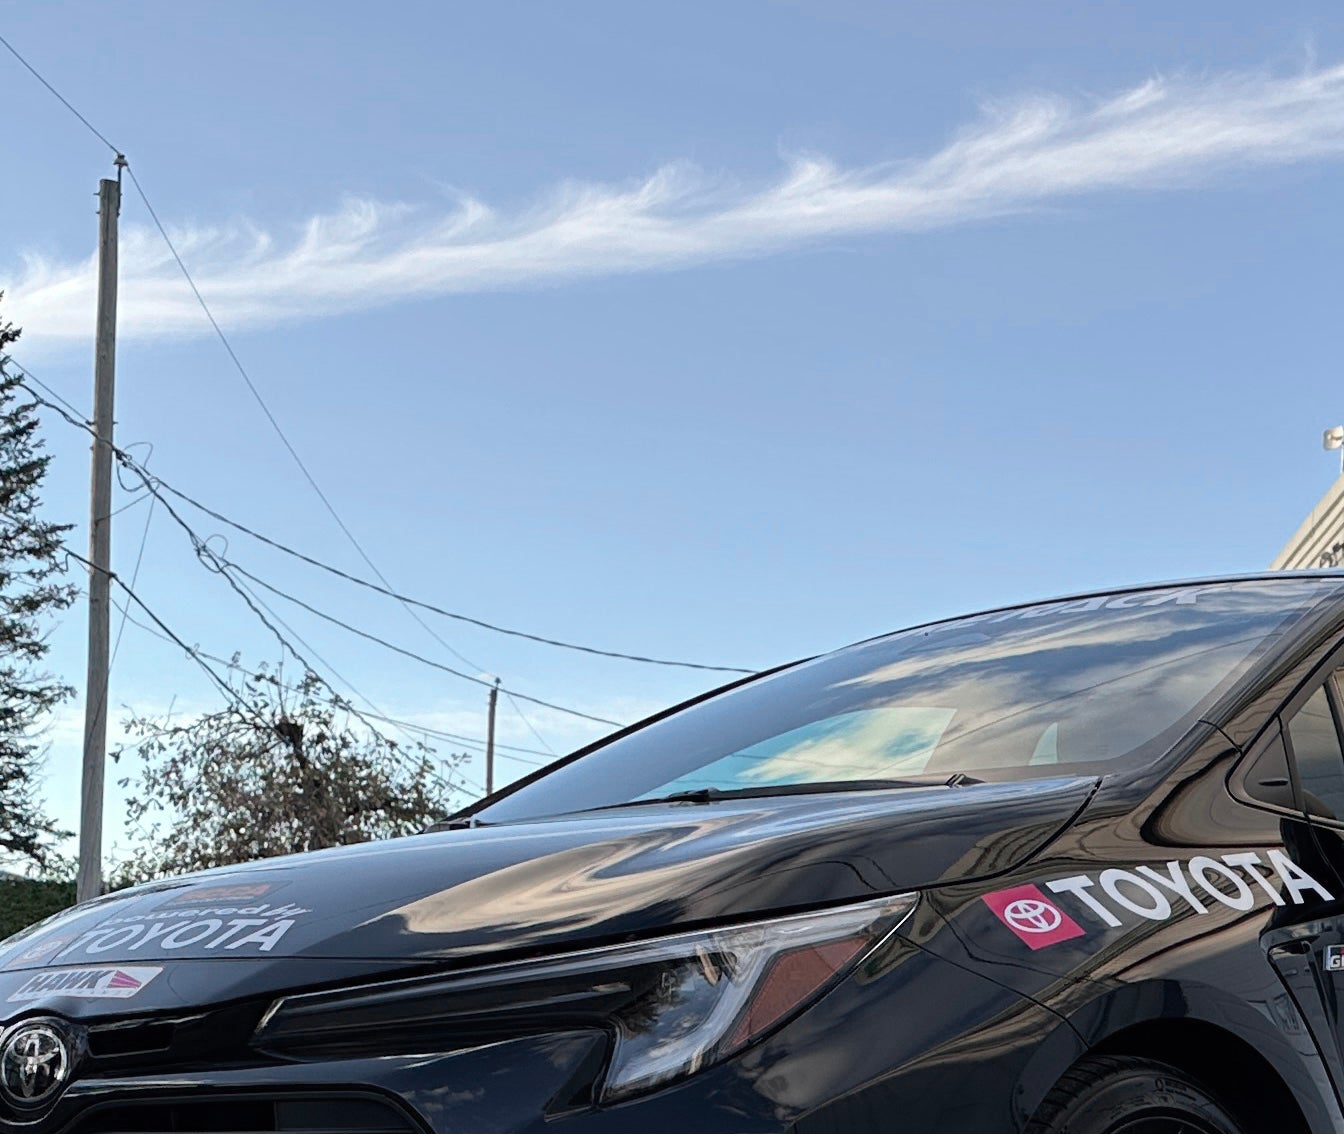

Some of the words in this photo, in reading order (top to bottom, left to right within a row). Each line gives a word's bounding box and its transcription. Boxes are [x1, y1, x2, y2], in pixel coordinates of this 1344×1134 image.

[1045, 849, 1336, 928] TOYOTA
[56, 919, 296, 958] TOYOTA
[17, 969, 117, 994] HAWK
